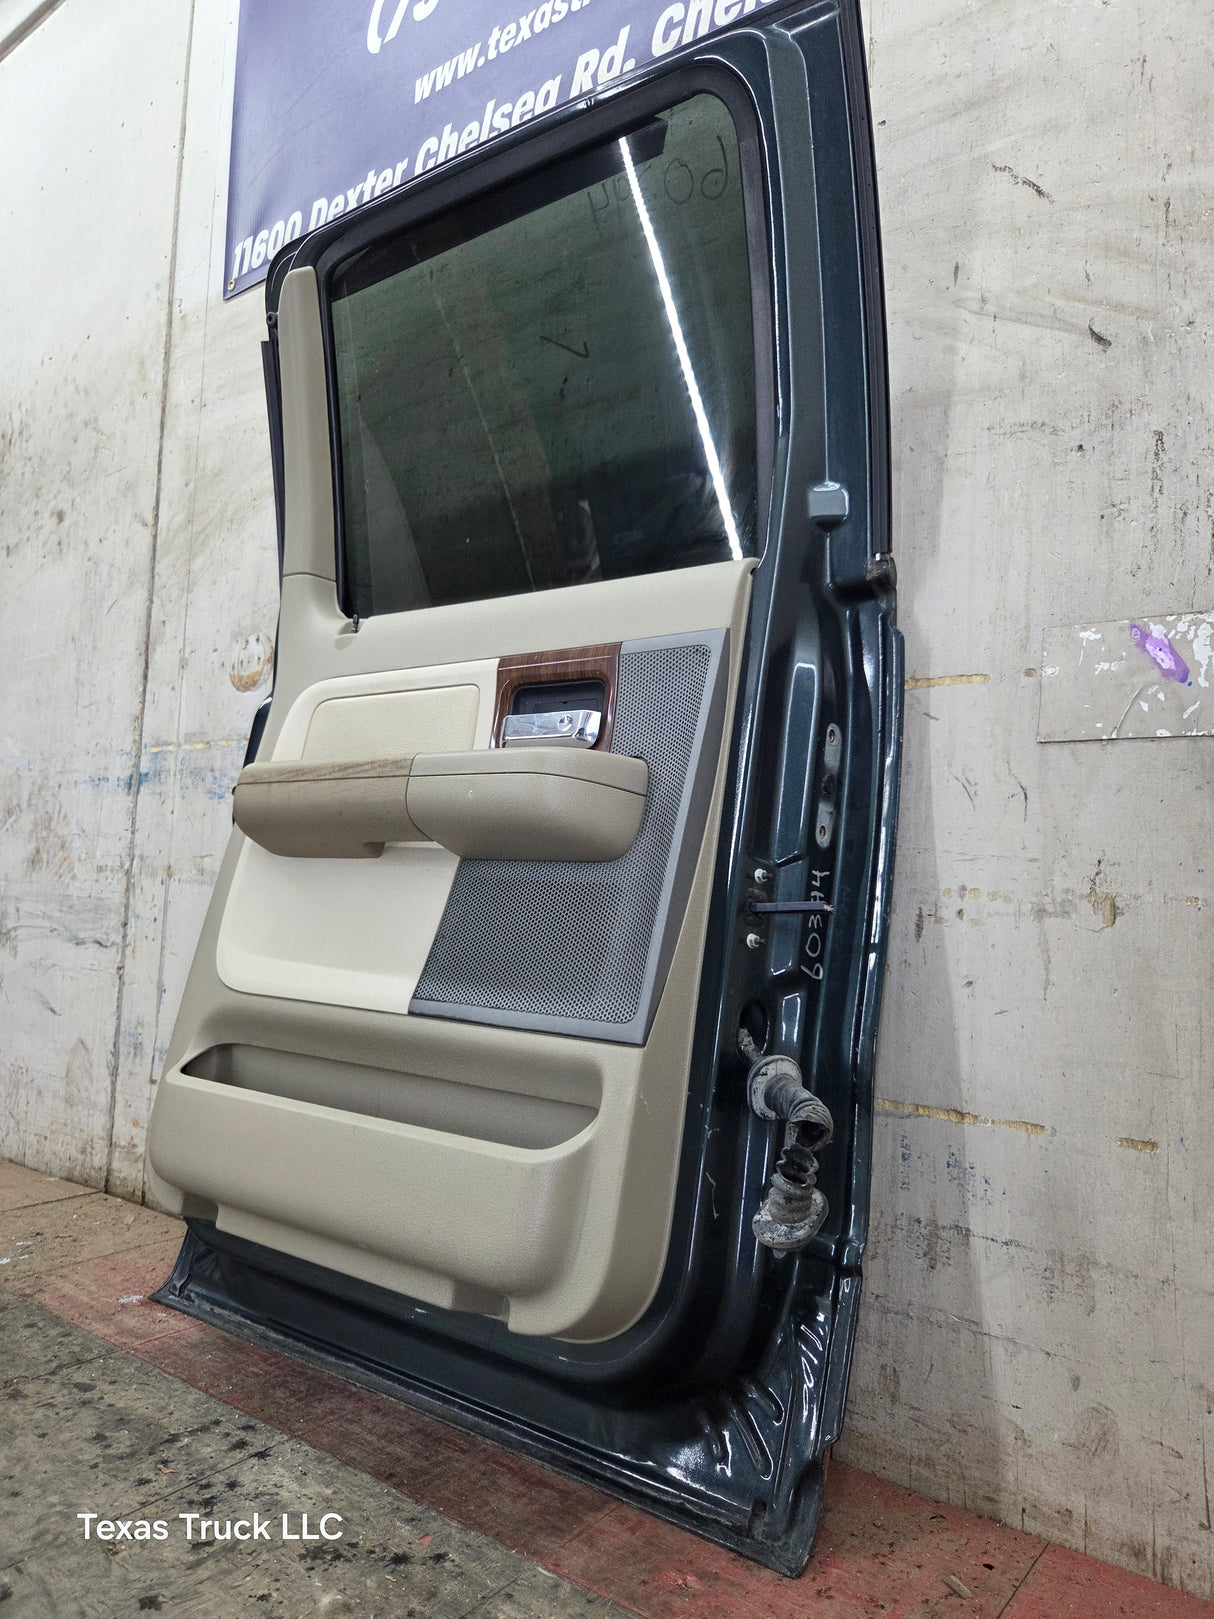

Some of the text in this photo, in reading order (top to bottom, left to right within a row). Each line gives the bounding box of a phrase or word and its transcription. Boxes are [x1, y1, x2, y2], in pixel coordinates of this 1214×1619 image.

[232, 210, 303, 280] 11600
[308, 157, 409, 232] Dexter
[414, 74, 562, 177] Chelsea
[569, 24, 635, 99] Rd.
